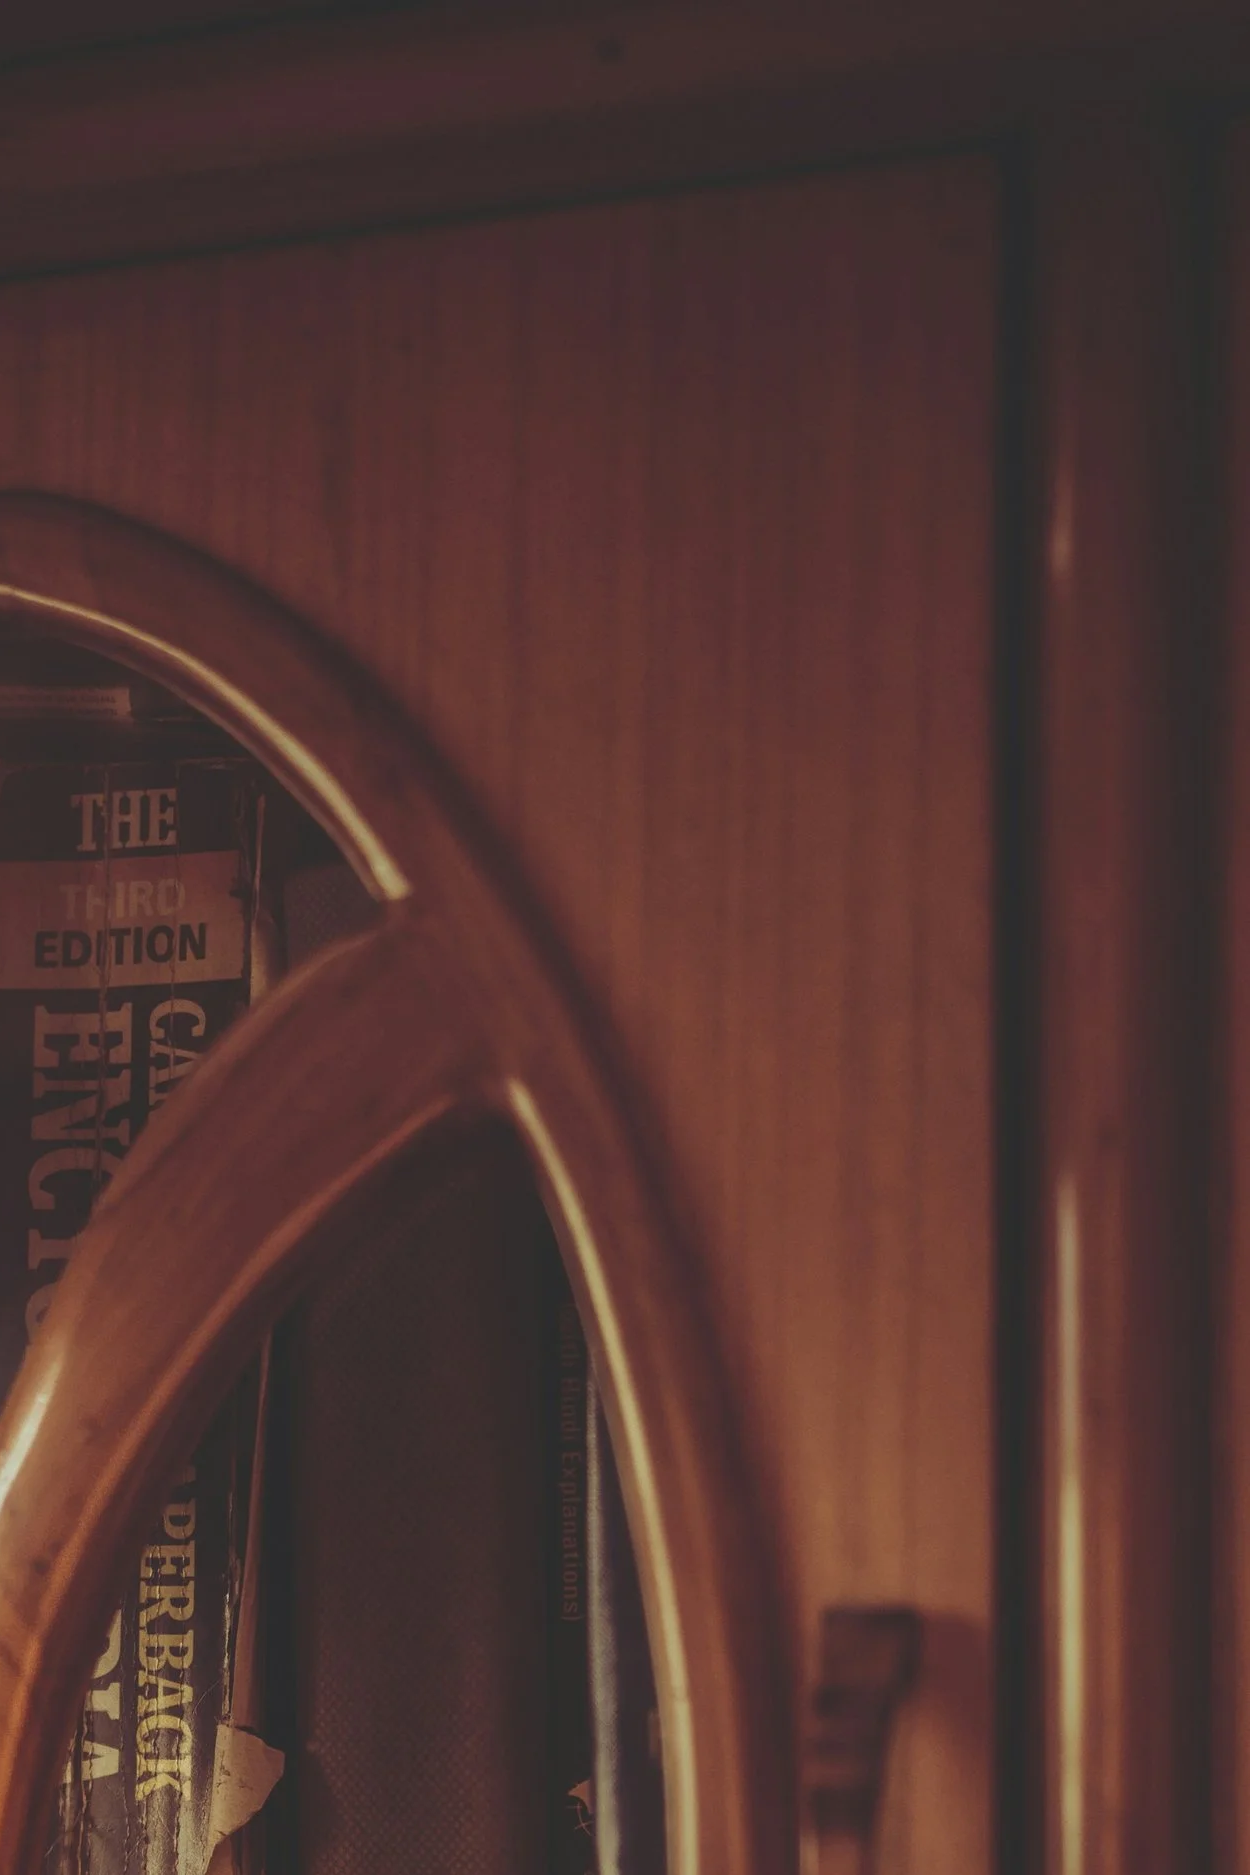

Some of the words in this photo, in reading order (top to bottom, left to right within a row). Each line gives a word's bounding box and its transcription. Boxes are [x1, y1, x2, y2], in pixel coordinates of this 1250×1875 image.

[70, 788, 178, 851] THE
[60, 878, 186, 920] THIRD
[34, 922, 208, 969] EDITION
[135, 1464, 197, 1802] PERBACK
